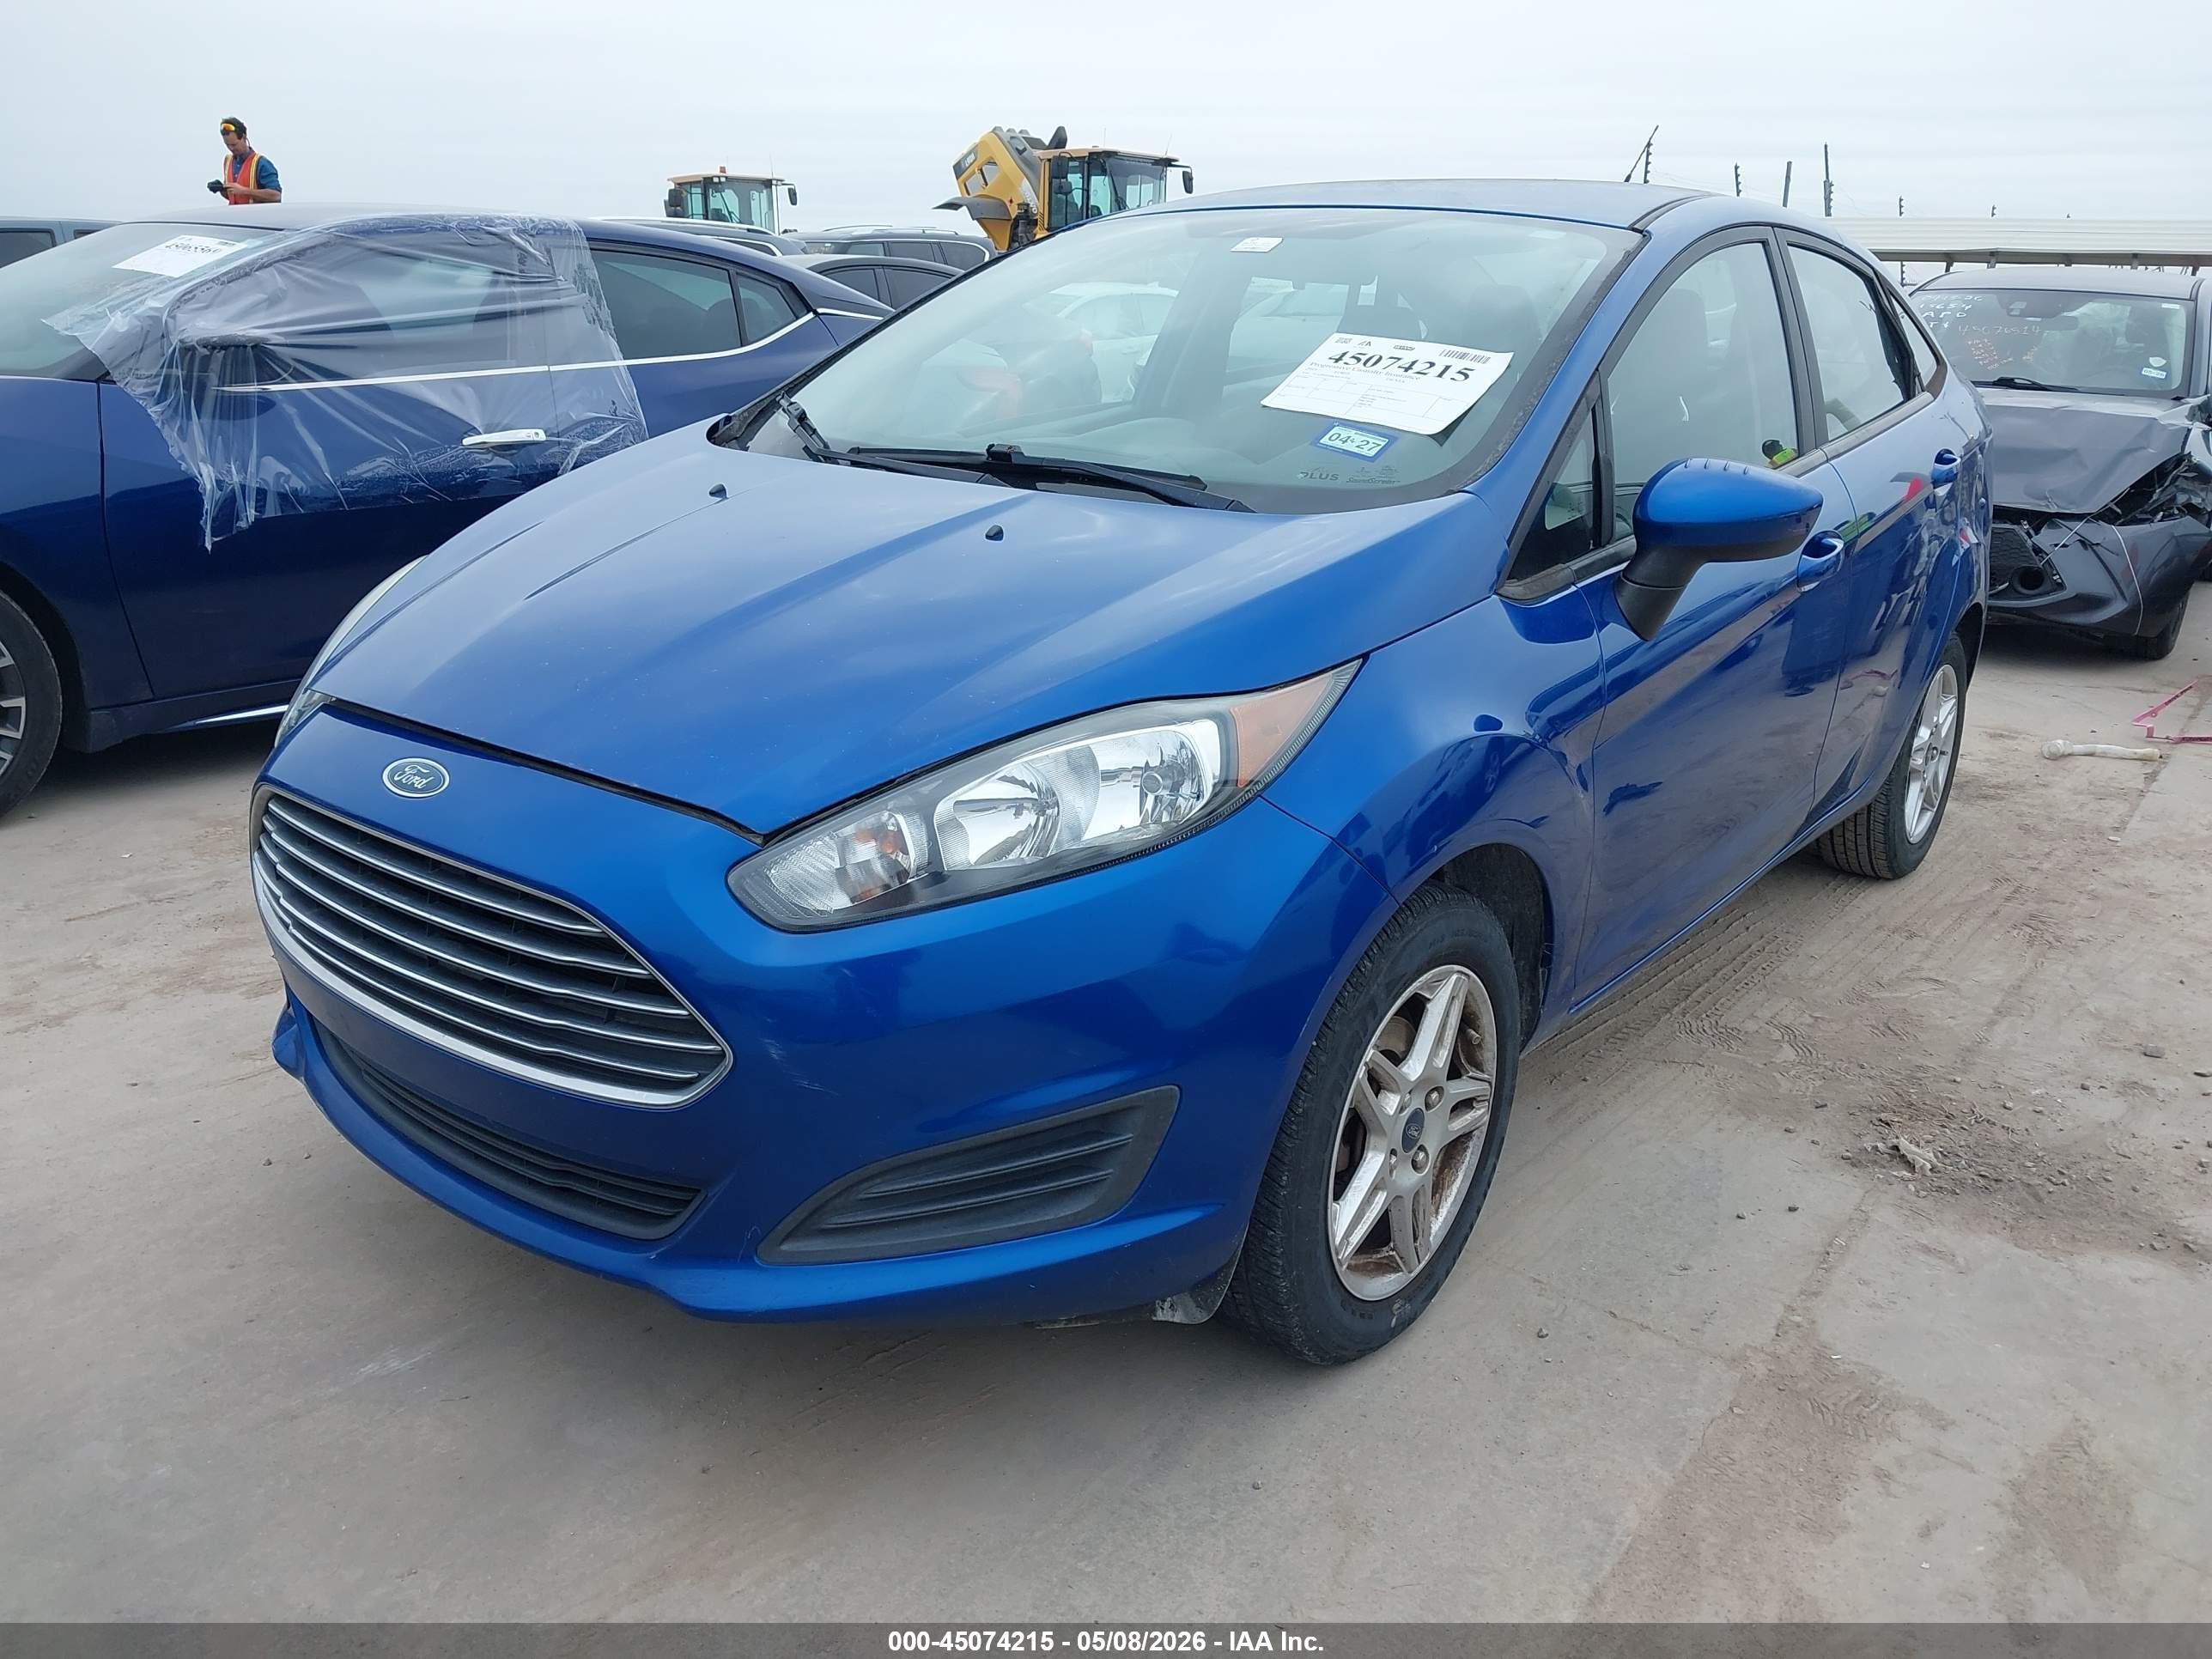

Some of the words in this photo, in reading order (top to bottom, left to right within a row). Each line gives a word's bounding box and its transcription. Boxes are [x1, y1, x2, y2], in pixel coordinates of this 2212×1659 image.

[1328, 350, 1476, 382] 45074215
[1328, 433, 1351, 445] 04
[1355, 440, 1382, 452] 27
[394, 764, 435, 788] Ford
